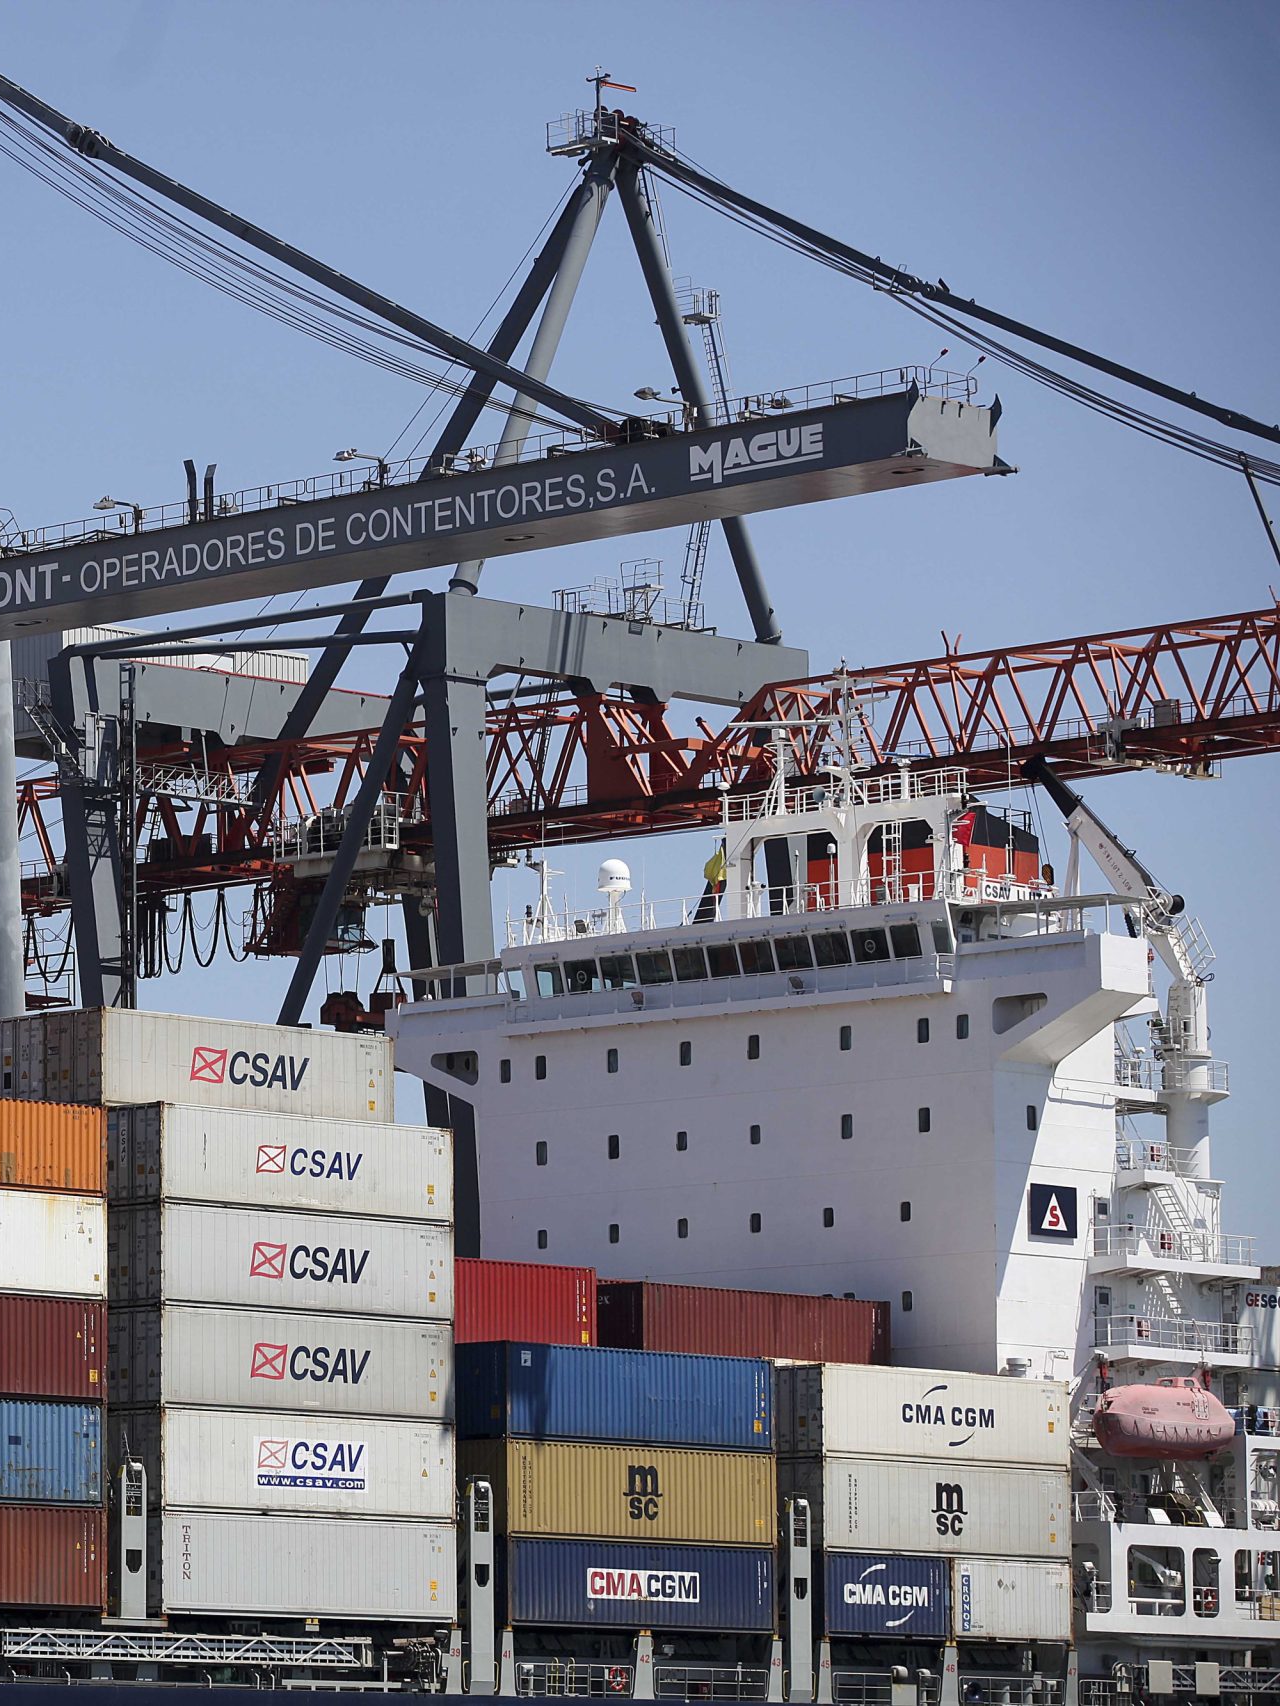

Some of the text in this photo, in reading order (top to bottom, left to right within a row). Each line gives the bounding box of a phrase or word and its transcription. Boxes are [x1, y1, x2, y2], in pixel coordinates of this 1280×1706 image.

[689, 423, 823, 482] MAGUE
[80, 530, 285, 593] OPERADORES
[296, 521, 336, 555] DE
[985, 885, 1010, 900] CSAV
[229, 1051, 310, 1091] CSAV
[290, 1148, 362, 1181] CSAV
[1048, 1205, 1060, 1227] S
[289, 1245, 370, 1284] CSAV
[1245, 1292, 1280, 1309] GEse
[289, 1345, 371, 1385] CSAV
[902, 1403, 995, 1429] CMA CGM
[291, 1441, 364, 1473] CSAV
[258, 1475, 365, 1490] www.csav.com
[182, 1525, 191, 1580] TRITON
[590, 1571, 698, 1600] CMA CGM
[843, 1583, 886, 1605] CMA
[888, 1585, 929, 1607] CGM
[962, 1577, 970, 1630] CRONOS
[450, 1648, 461, 1658] 39
[502, 1650, 511, 1660] 41
[640, 1654, 650, 1664] 42
[771, 1657, 781, 1667] 43
[821, 1660, 830, 1669] 45
[945, 1664, 955, 1673] 46
[1068, 1668, 1077, 1676] 47
